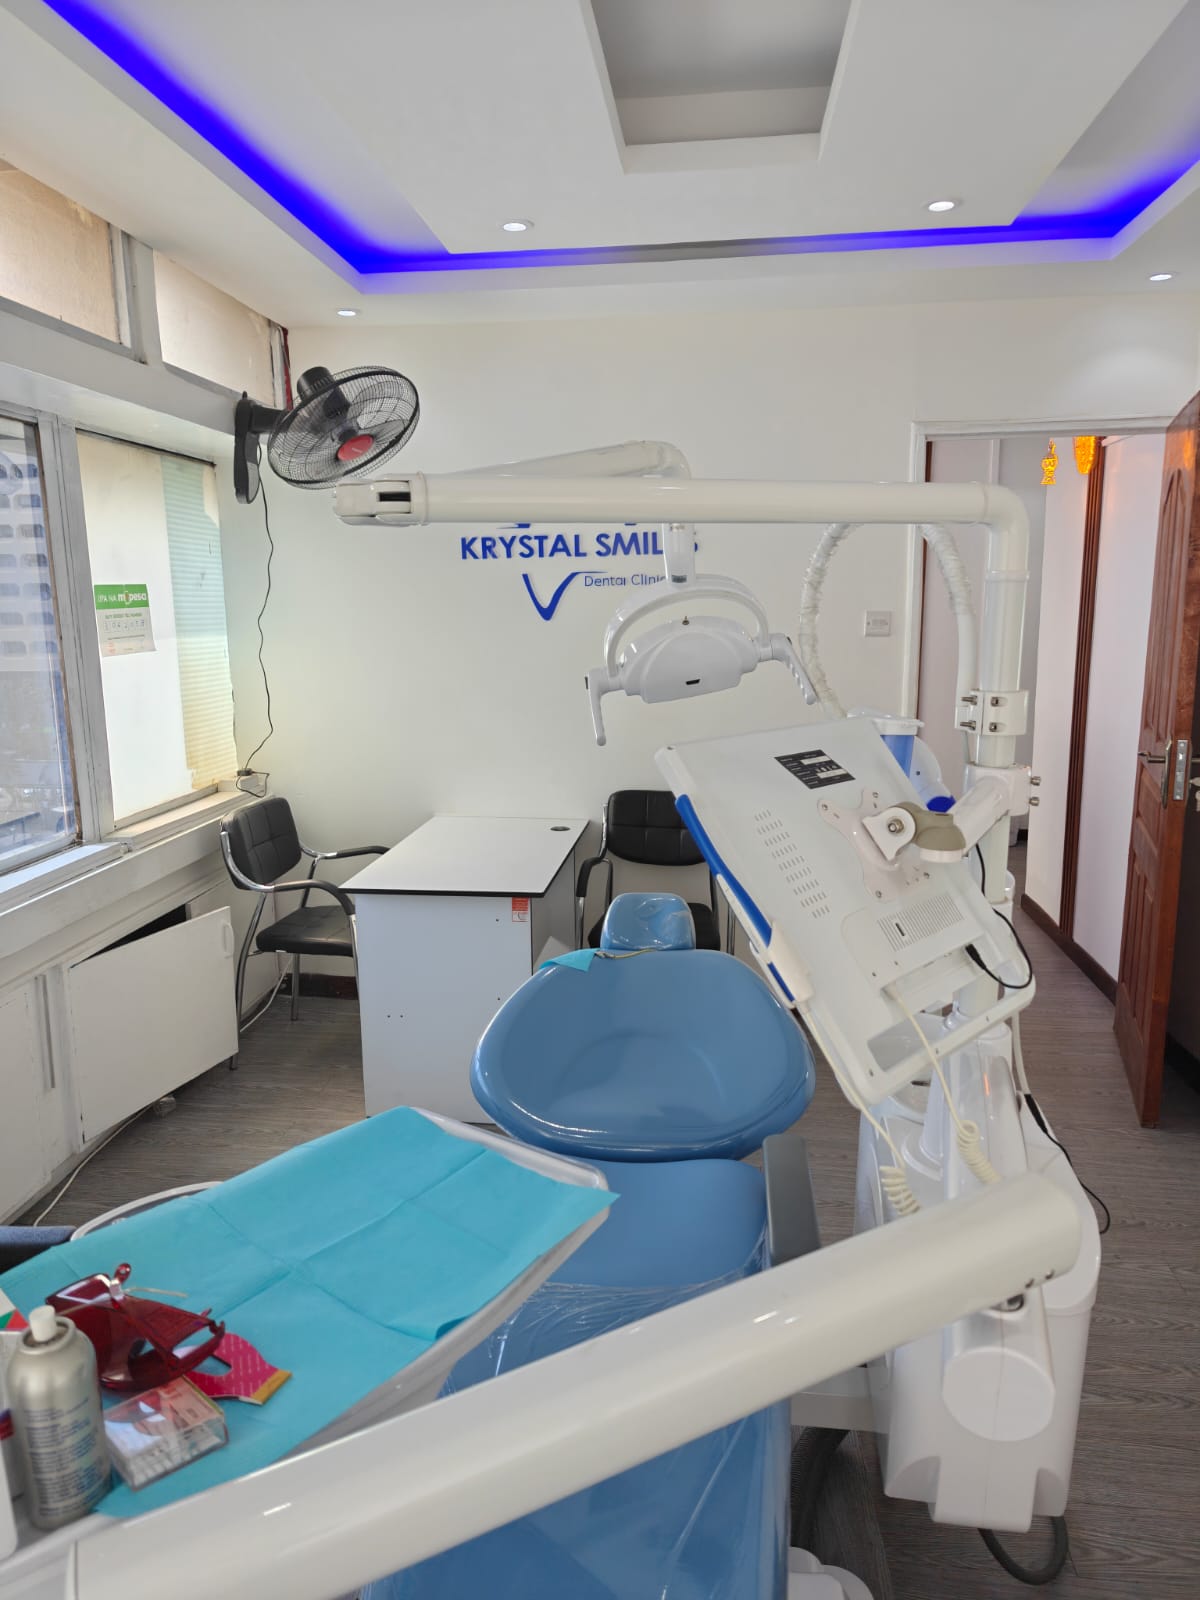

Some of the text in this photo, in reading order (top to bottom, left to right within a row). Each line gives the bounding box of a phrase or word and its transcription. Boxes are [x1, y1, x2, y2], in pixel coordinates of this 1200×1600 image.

[460, 531, 699, 560] KRYSTAL SMIL
[584, 575, 627, 587] Dental
